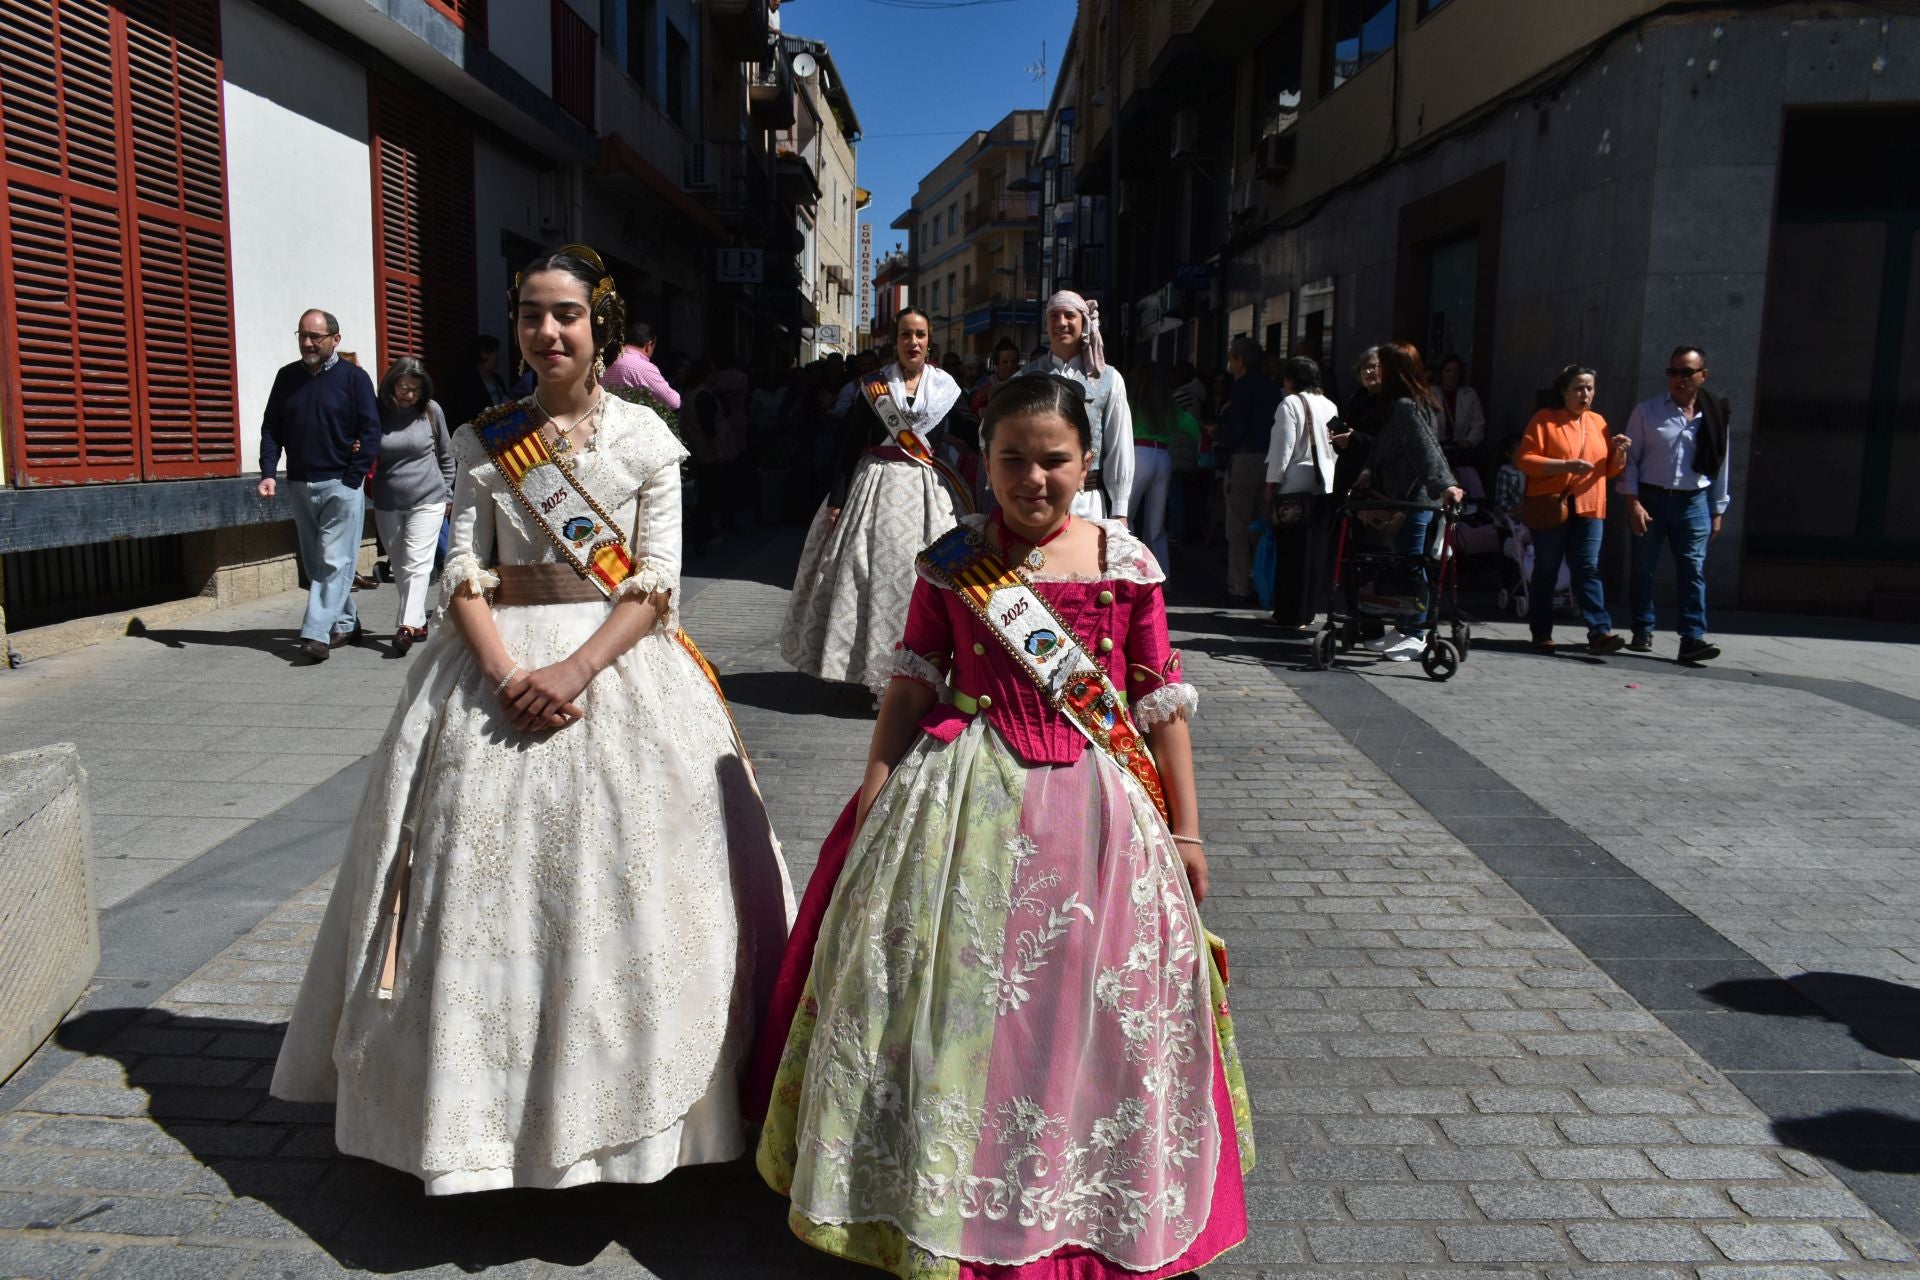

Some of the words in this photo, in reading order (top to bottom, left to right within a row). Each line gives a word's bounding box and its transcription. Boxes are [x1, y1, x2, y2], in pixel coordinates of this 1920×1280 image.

[861, 225, 870, 272] COMIDAS
[861, 275, 869, 322] CASERAS
[540, 487, 568, 514] 2025
[1000, 596, 1029, 627] 2025
